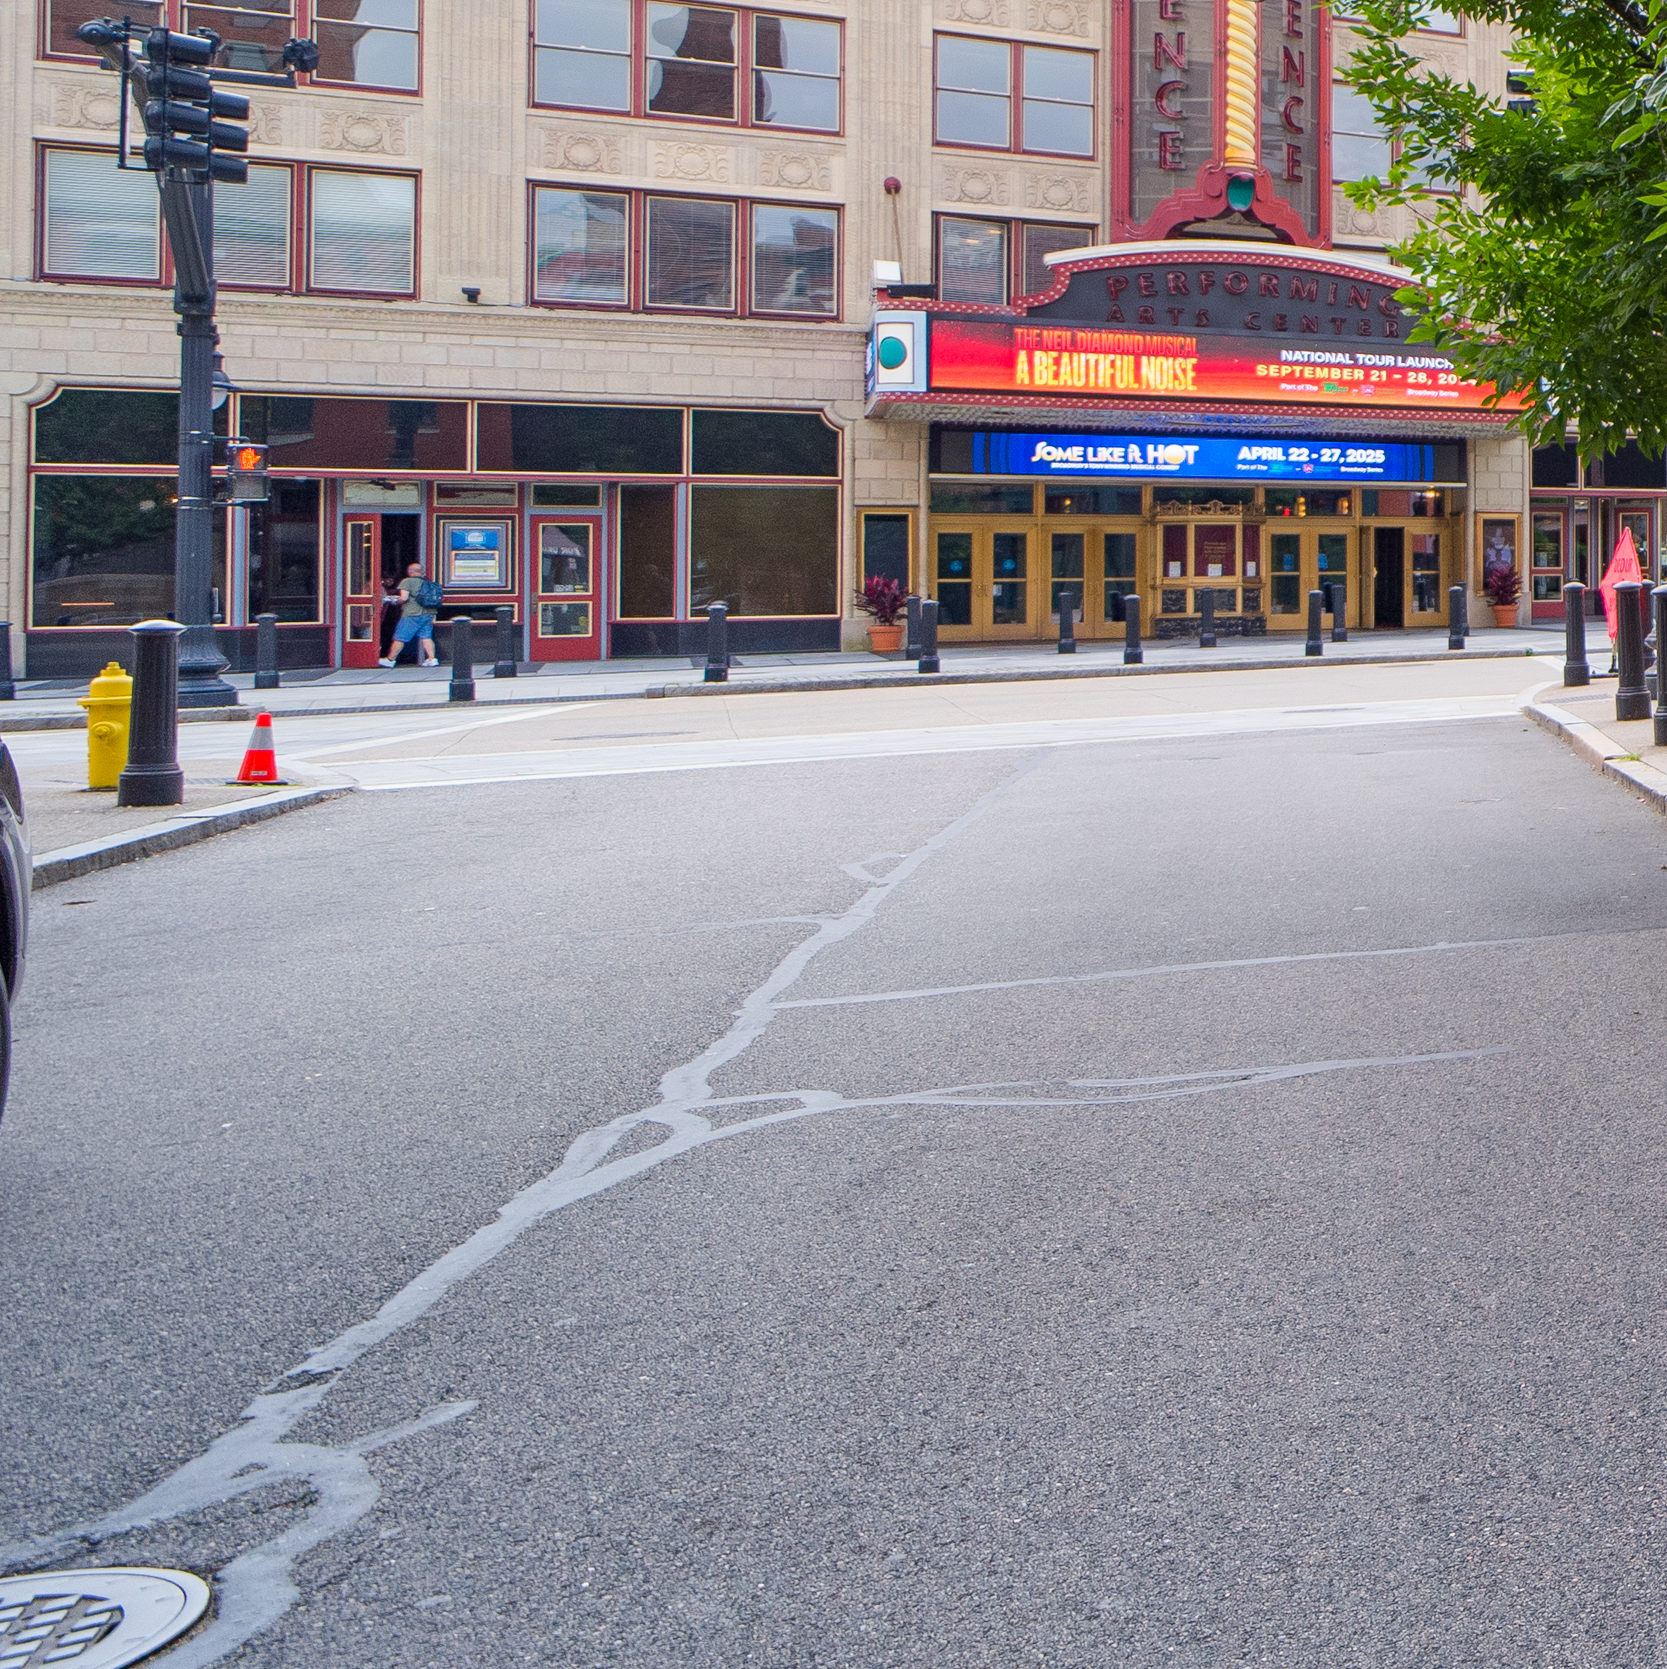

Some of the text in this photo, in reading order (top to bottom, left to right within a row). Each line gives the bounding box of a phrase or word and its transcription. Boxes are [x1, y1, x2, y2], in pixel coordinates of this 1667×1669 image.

[1105, 270, 1400, 318] PERFORMING
[1105, 303, 1400, 339] ARTS CENTER
[1014, 328, 1199, 357] THE NEIL DIAMOND MUSICAL
[1016, 350, 1198, 392] A BEAUTIFUL NOISE
[1280, 350, 1455, 370] NATIONAL TOUR LAUNCH
[1256, 364, 1365, 381] SEPTEMBER
[1370, 370, 1387, 382] 21
[1407, 372, 1433, 385] 28,
[1280, 383, 1297, 391] Part
[1298, 383, 1308, 391] of
[1406, 388, 1438, 398] Broadway
[1439, 390, 1460, 398] Series
[1031, 441, 1085, 462] SOME
[1147, 444, 1199, 465] HOT
[1238, 446, 1286, 461] APRIL
[1288, 447, 1310, 462] 22
[1320, 448, 1346, 464] 27,
[1346, 449, 1386, 464] 2025
